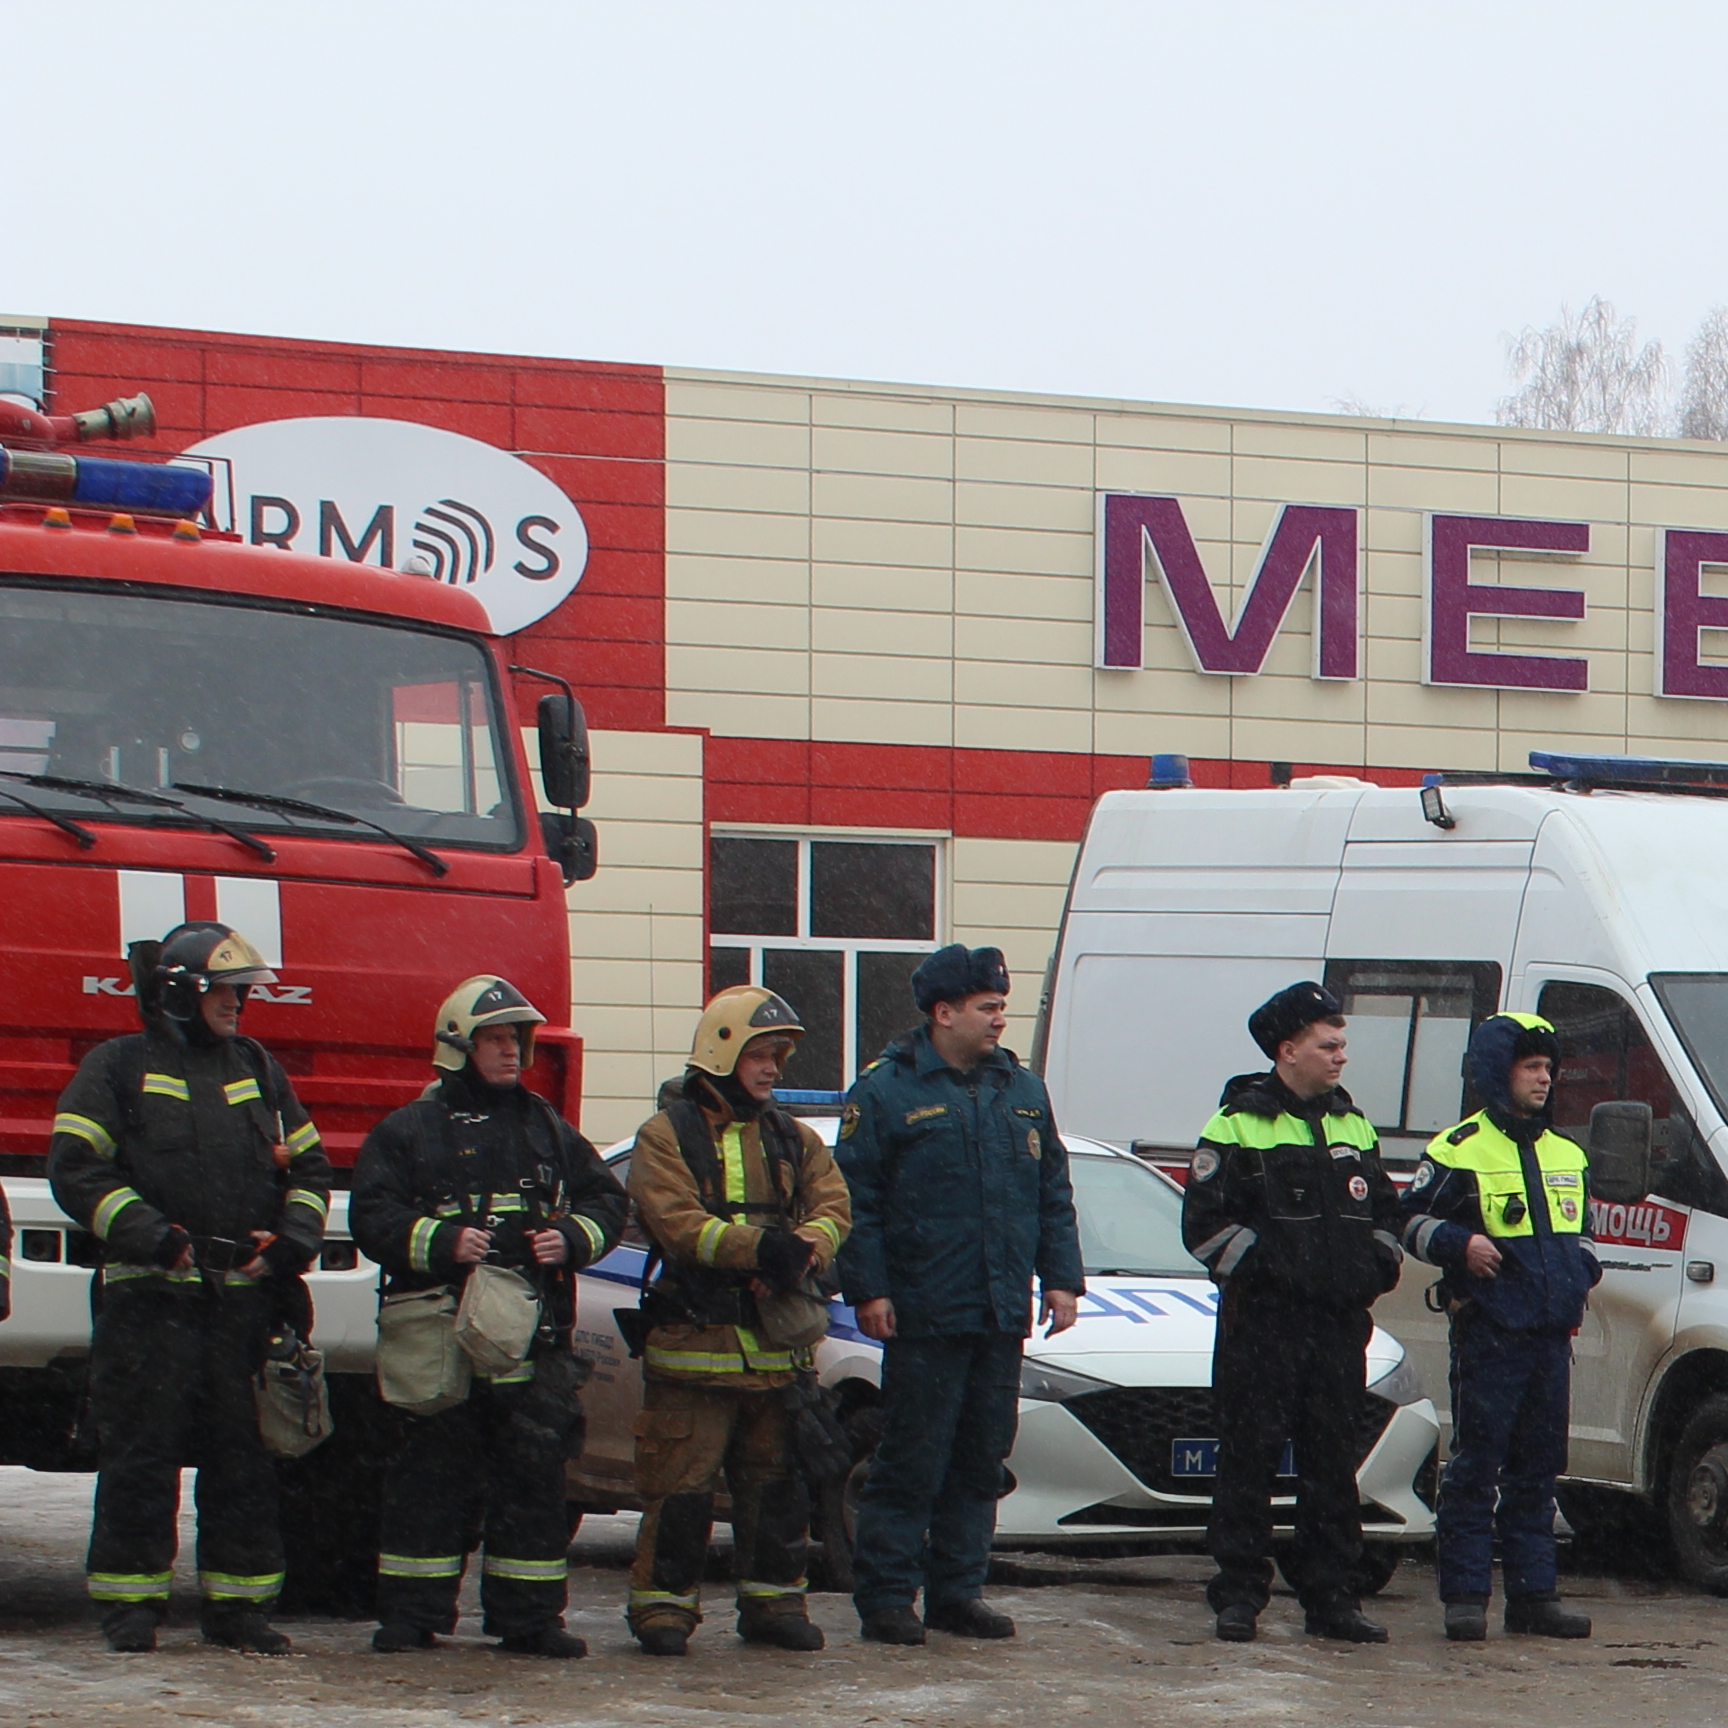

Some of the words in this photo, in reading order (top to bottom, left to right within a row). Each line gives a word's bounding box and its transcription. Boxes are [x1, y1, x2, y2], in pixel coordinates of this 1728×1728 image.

[198, 494, 562, 585] RMOS
[488, 990, 503, 1002] 17
[763, 1009, 777, 1019] 17
[1033, 1288, 1220, 1325] ДП
